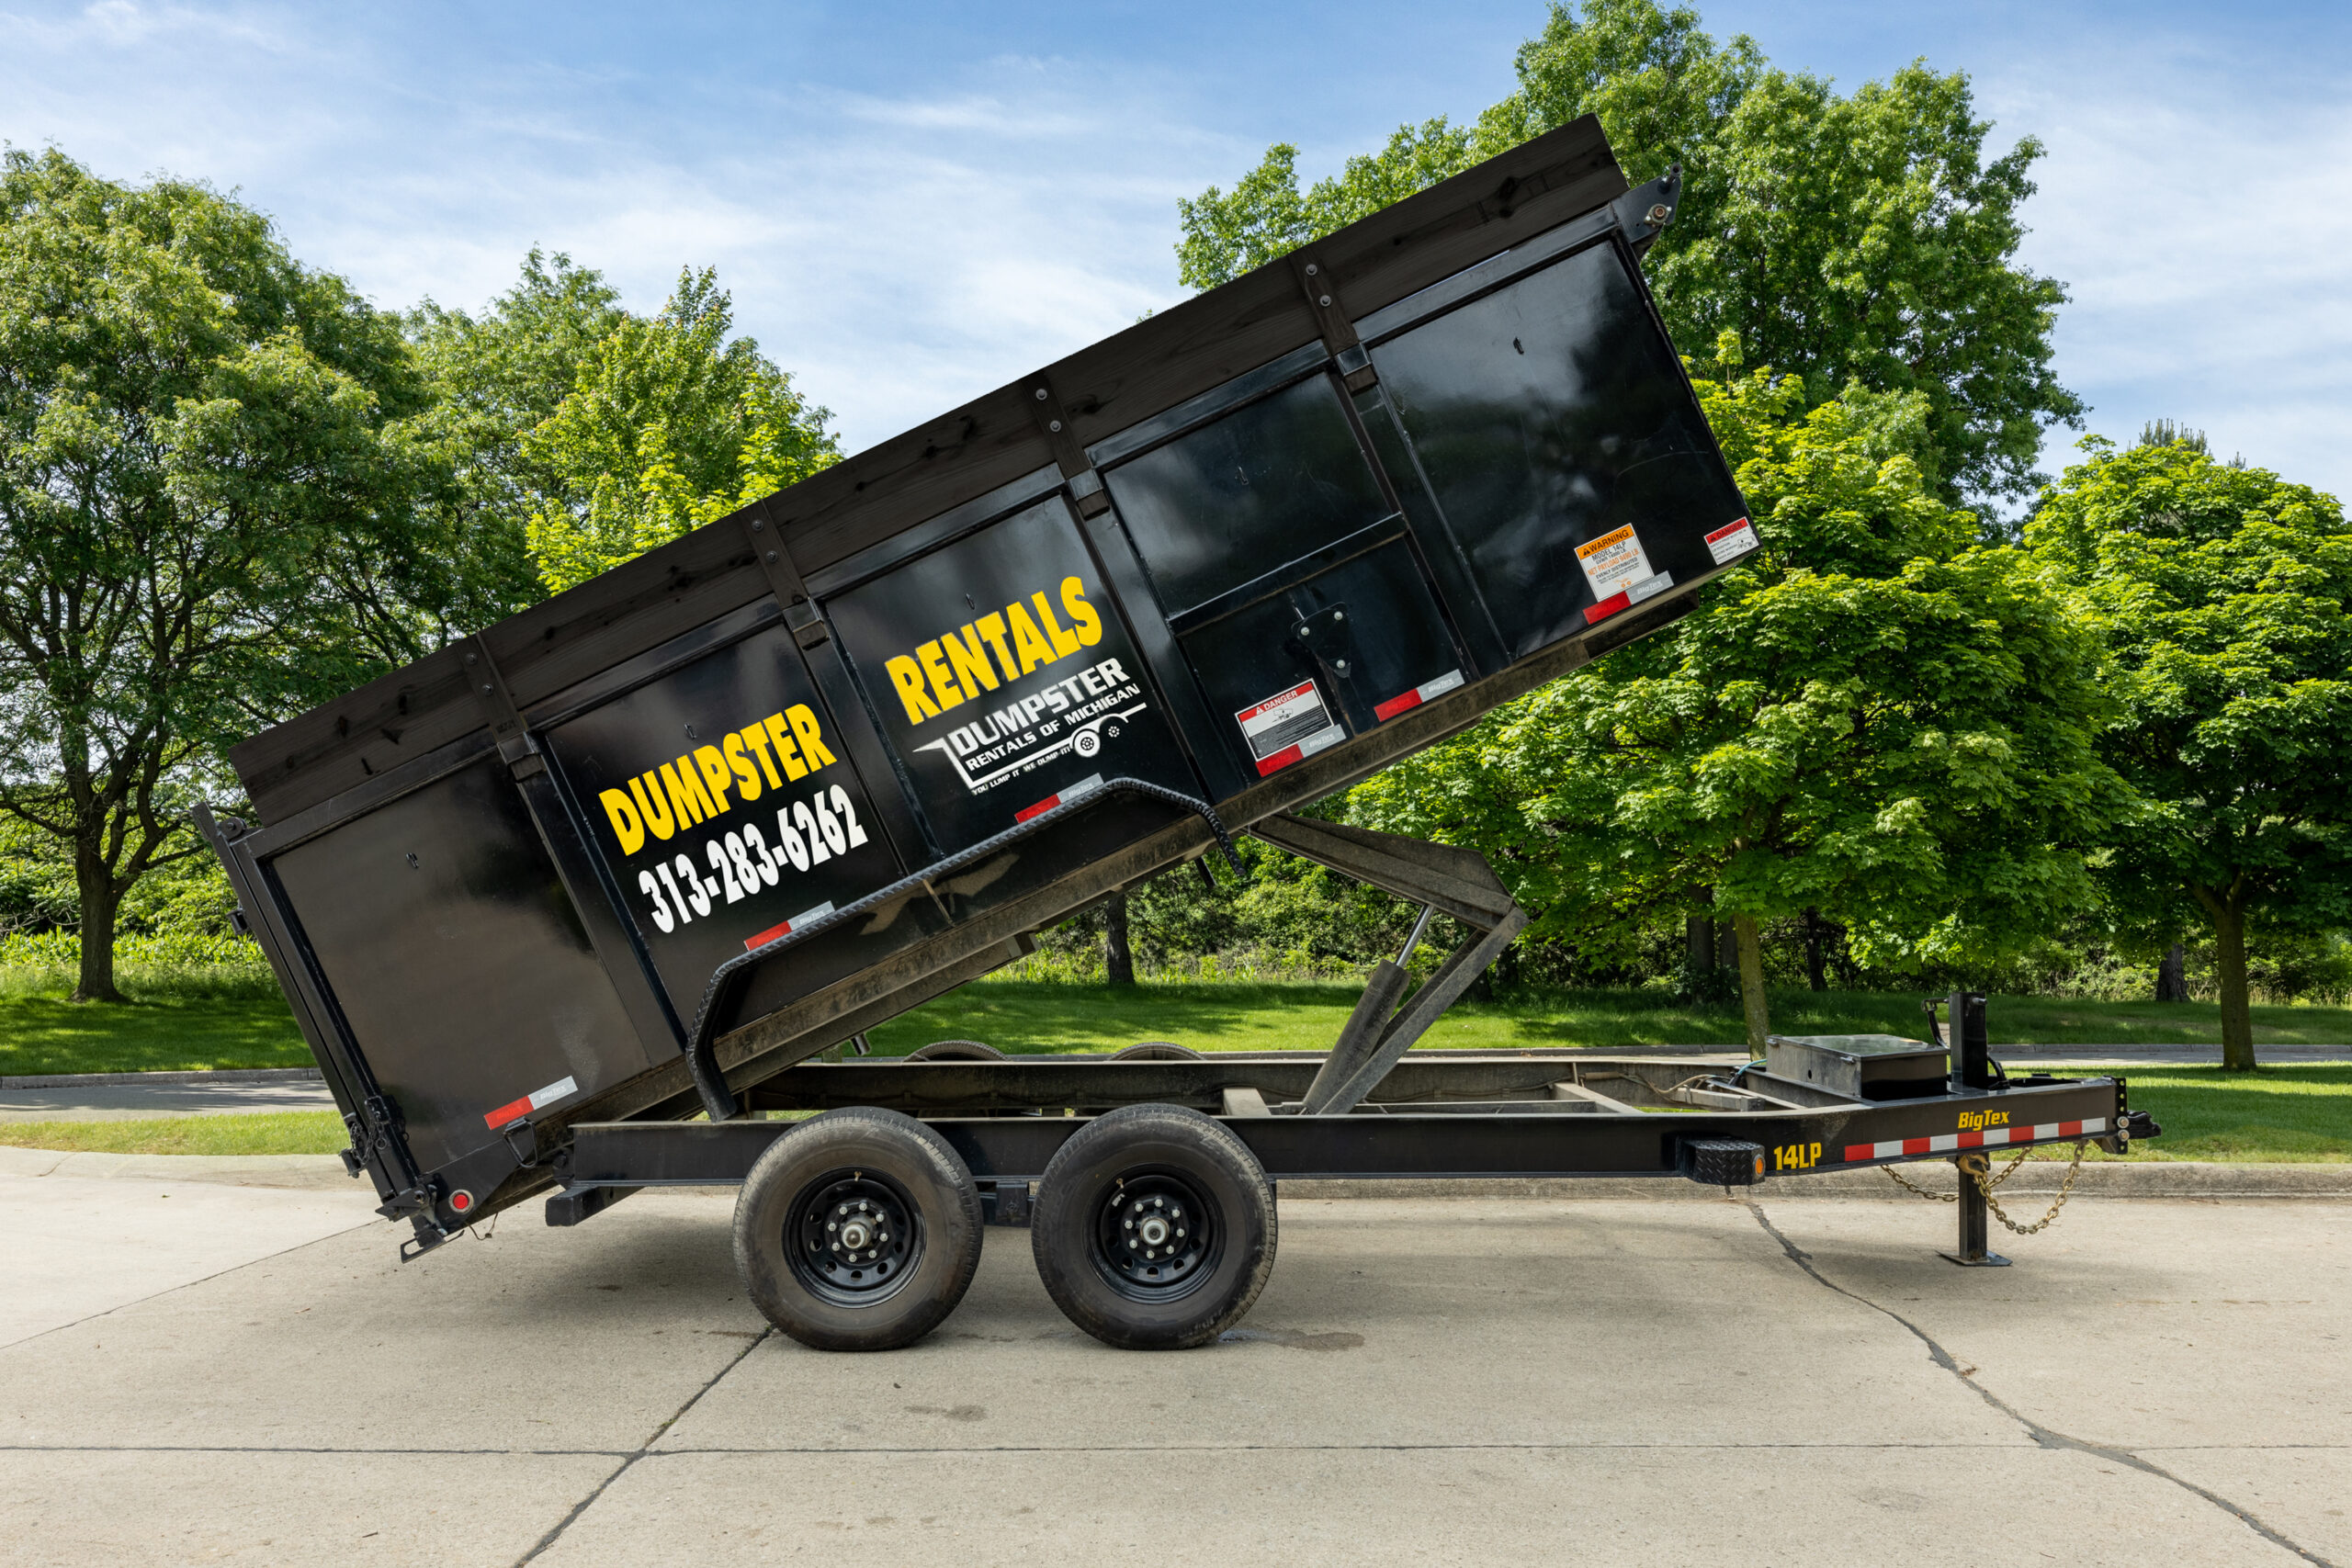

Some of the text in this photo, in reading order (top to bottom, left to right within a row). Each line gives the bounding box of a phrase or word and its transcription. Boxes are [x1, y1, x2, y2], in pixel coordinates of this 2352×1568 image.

[1589, 529, 1629, 552] WARNING
[1591, 541, 1626, 561] MODEL 14LP
[1598, 558, 1620, 571] PAYLOAD
[1611, 557, 1638, 572] DISTRIBUTED
[885, 576, 1102, 726] RENTALS
[947, 658, 1130, 756] DUMPSTER
[1263, 690, 1298, 710] DANGER
[966, 683, 1140, 771] RENTALS OF MICHIGAN
[598, 704, 837, 856] DUMPSTER
[971, 785, 989, 795] YOU
[989, 774, 1011, 788] LUMP
[1012, 770, 1020, 778] IT
[1023, 762, 1035, 773] WE
[1037, 752, 1058, 766] DUMP
[639, 784, 868, 933] 313-283-6262
[1958, 1109, 2009, 1131] BigTex
[1773, 1142, 1821, 1170] 14LP
